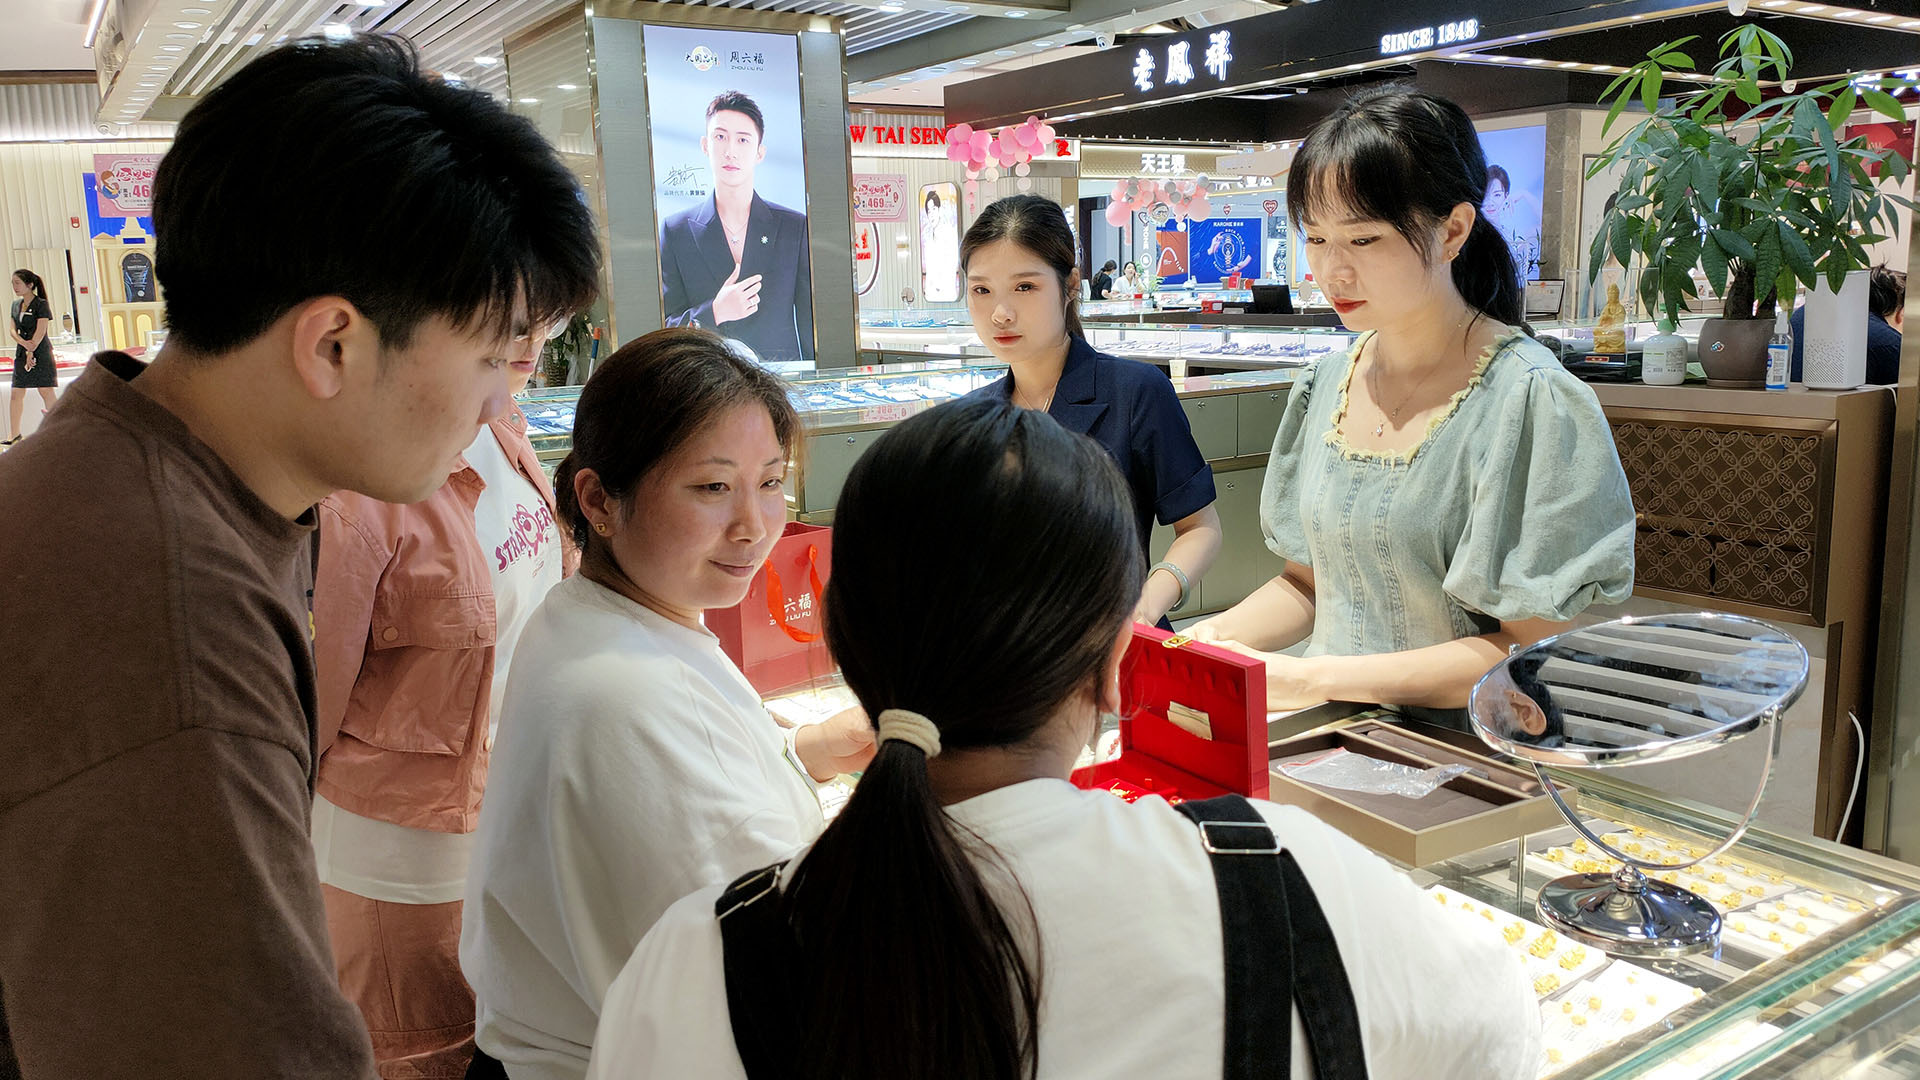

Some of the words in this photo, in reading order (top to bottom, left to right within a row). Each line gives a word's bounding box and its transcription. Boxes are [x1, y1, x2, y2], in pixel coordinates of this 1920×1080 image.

[1381, 27, 1434, 54] SINCE
[1437, 18, 1479, 45] 1848
[730, 51, 764, 65] 周六福
[873, 125, 905, 145] TAI
[133, 184, 152, 198] 46
[867, 197, 885, 208] 469
[801, 610, 811, 618] FU
